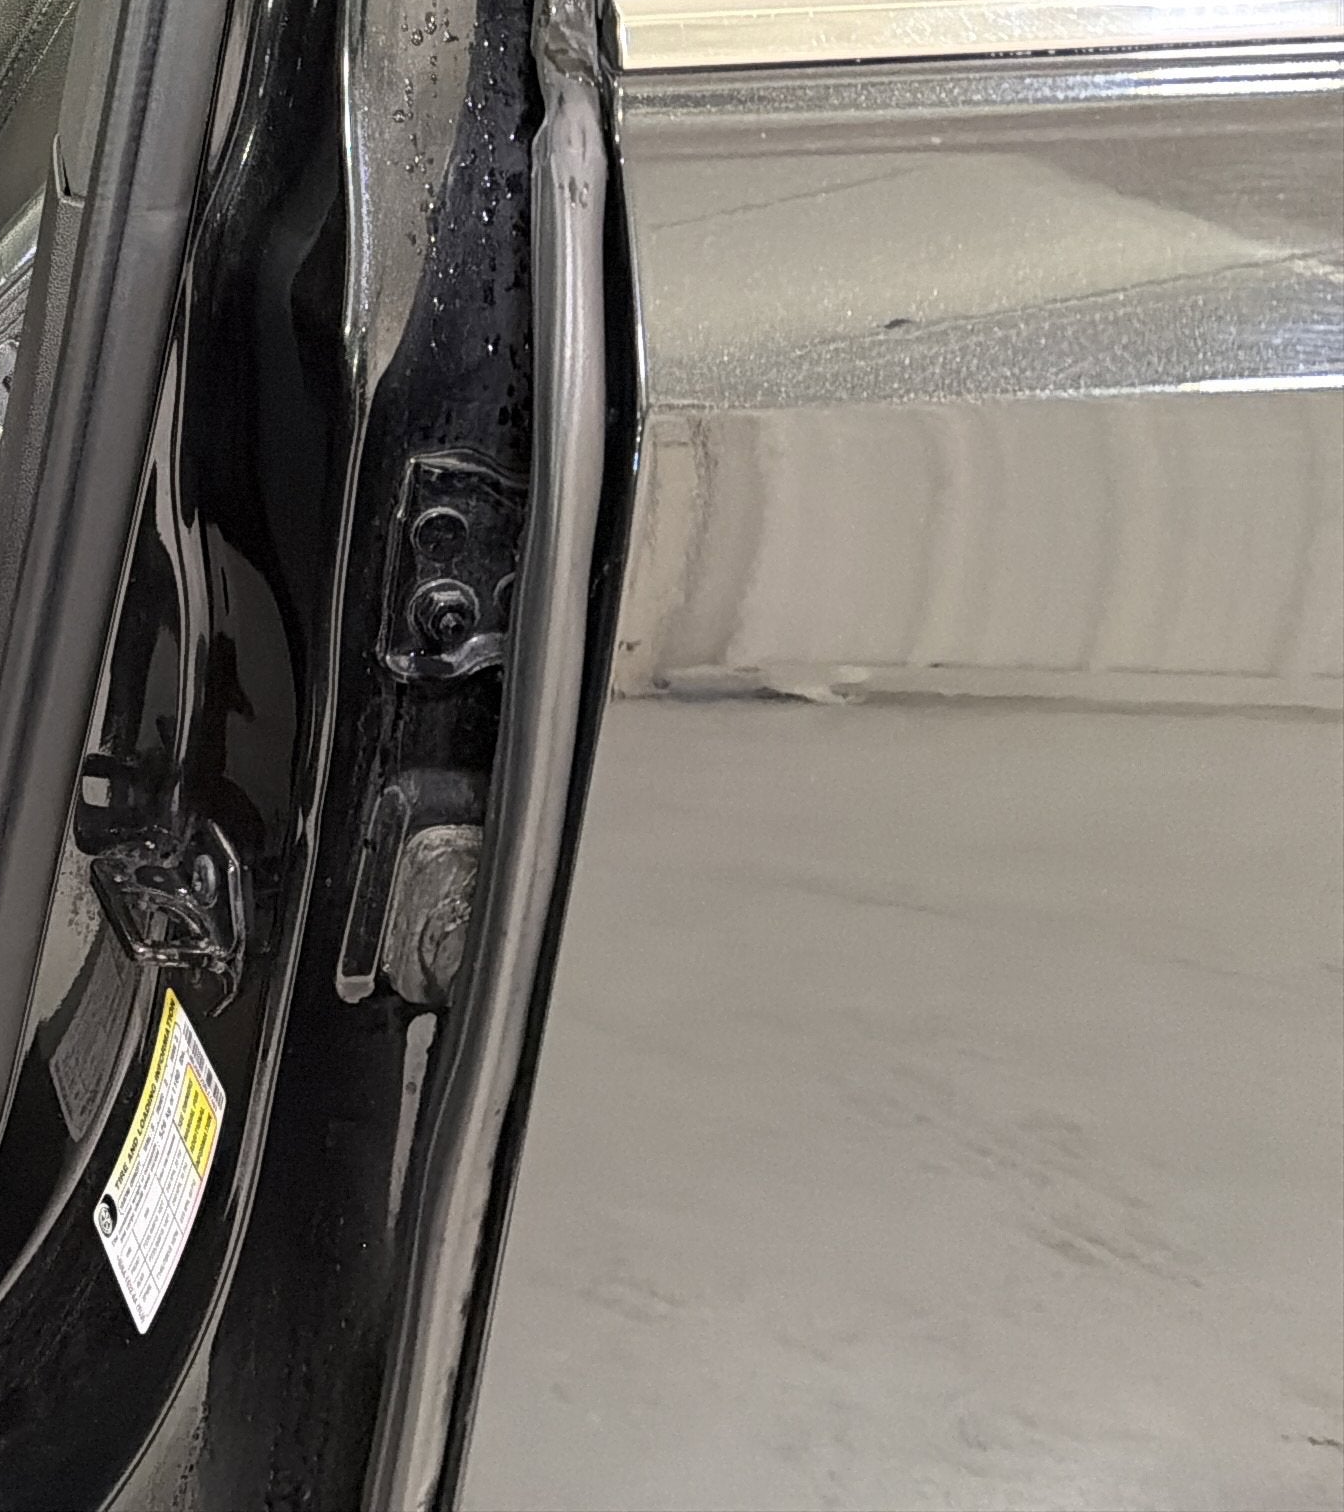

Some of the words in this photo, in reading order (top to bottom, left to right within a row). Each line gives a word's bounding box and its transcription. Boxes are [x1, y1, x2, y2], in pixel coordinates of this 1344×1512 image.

[115, 1162, 128, 1190] TIRE
[127, 1137, 139, 1163] AND
[137, 1082, 157, 1137] LOADING
[154, 997, 176, 1083] INFORMATION
